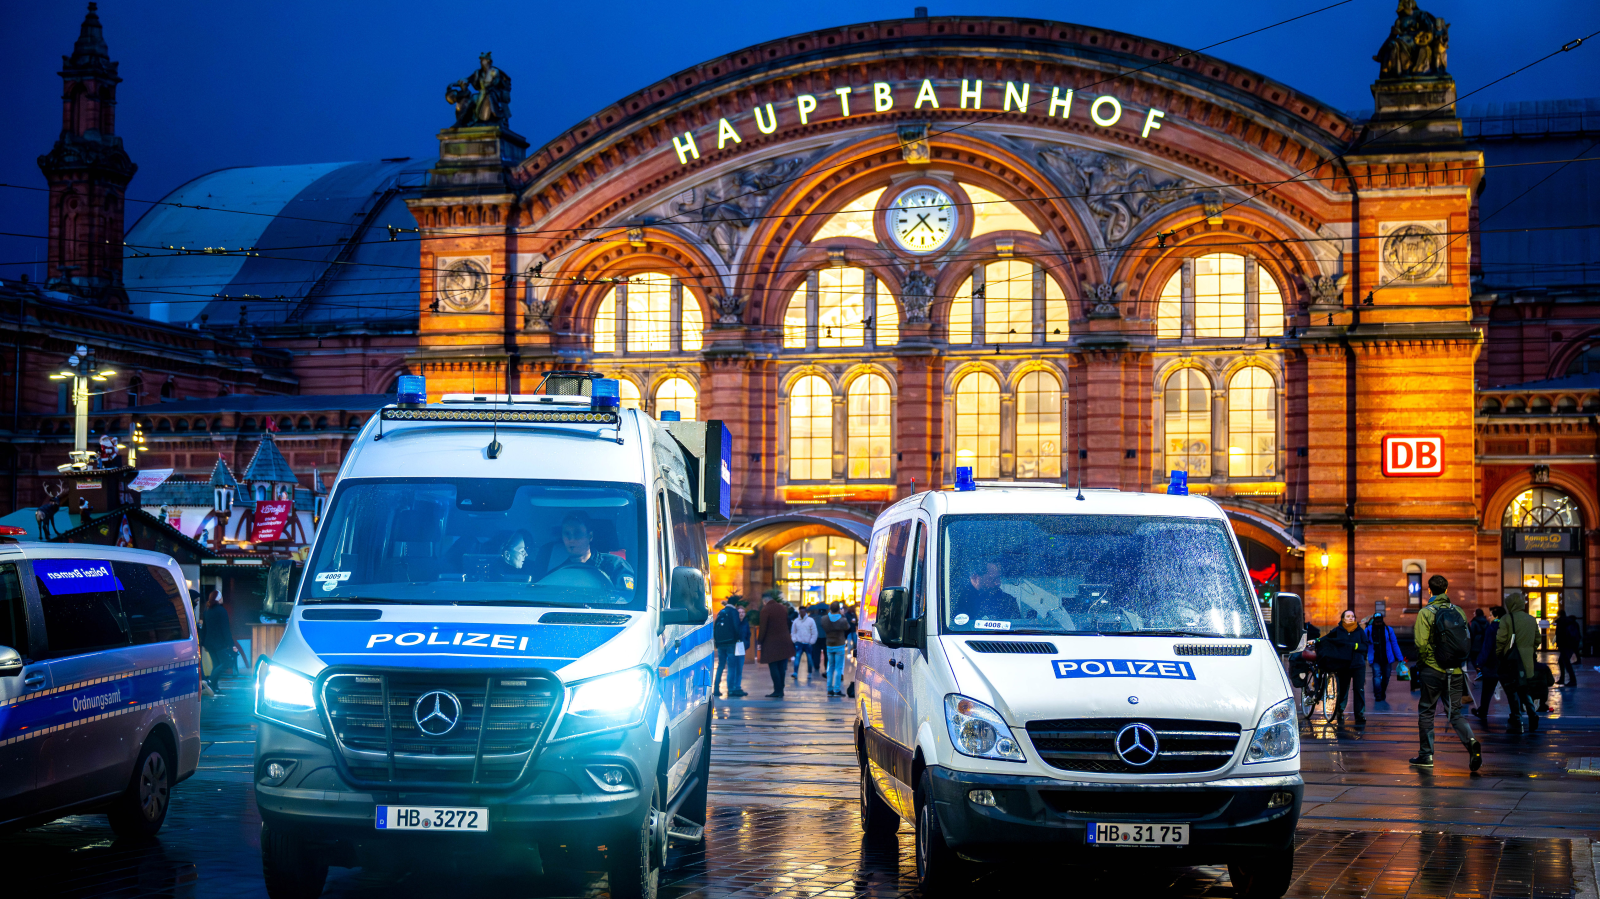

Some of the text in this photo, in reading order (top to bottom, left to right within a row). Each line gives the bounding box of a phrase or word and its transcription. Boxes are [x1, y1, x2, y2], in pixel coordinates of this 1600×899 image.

[672, 79, 1165, 165] HAUPTBAHNHOF
[1391, 441, 1437, 469] DB
[366, 632, 529, 651] POLIZEI
[1057, 661, 1190, 677] POLIZEI
[72, 689, 121, 712] Ordnungsamt
[396, 808, 420, 827] HB
[433, 809, 478, 828] 3272
[1097, 825, 1120, 842] HB
[1132, 826, 1182, 843] 3175
